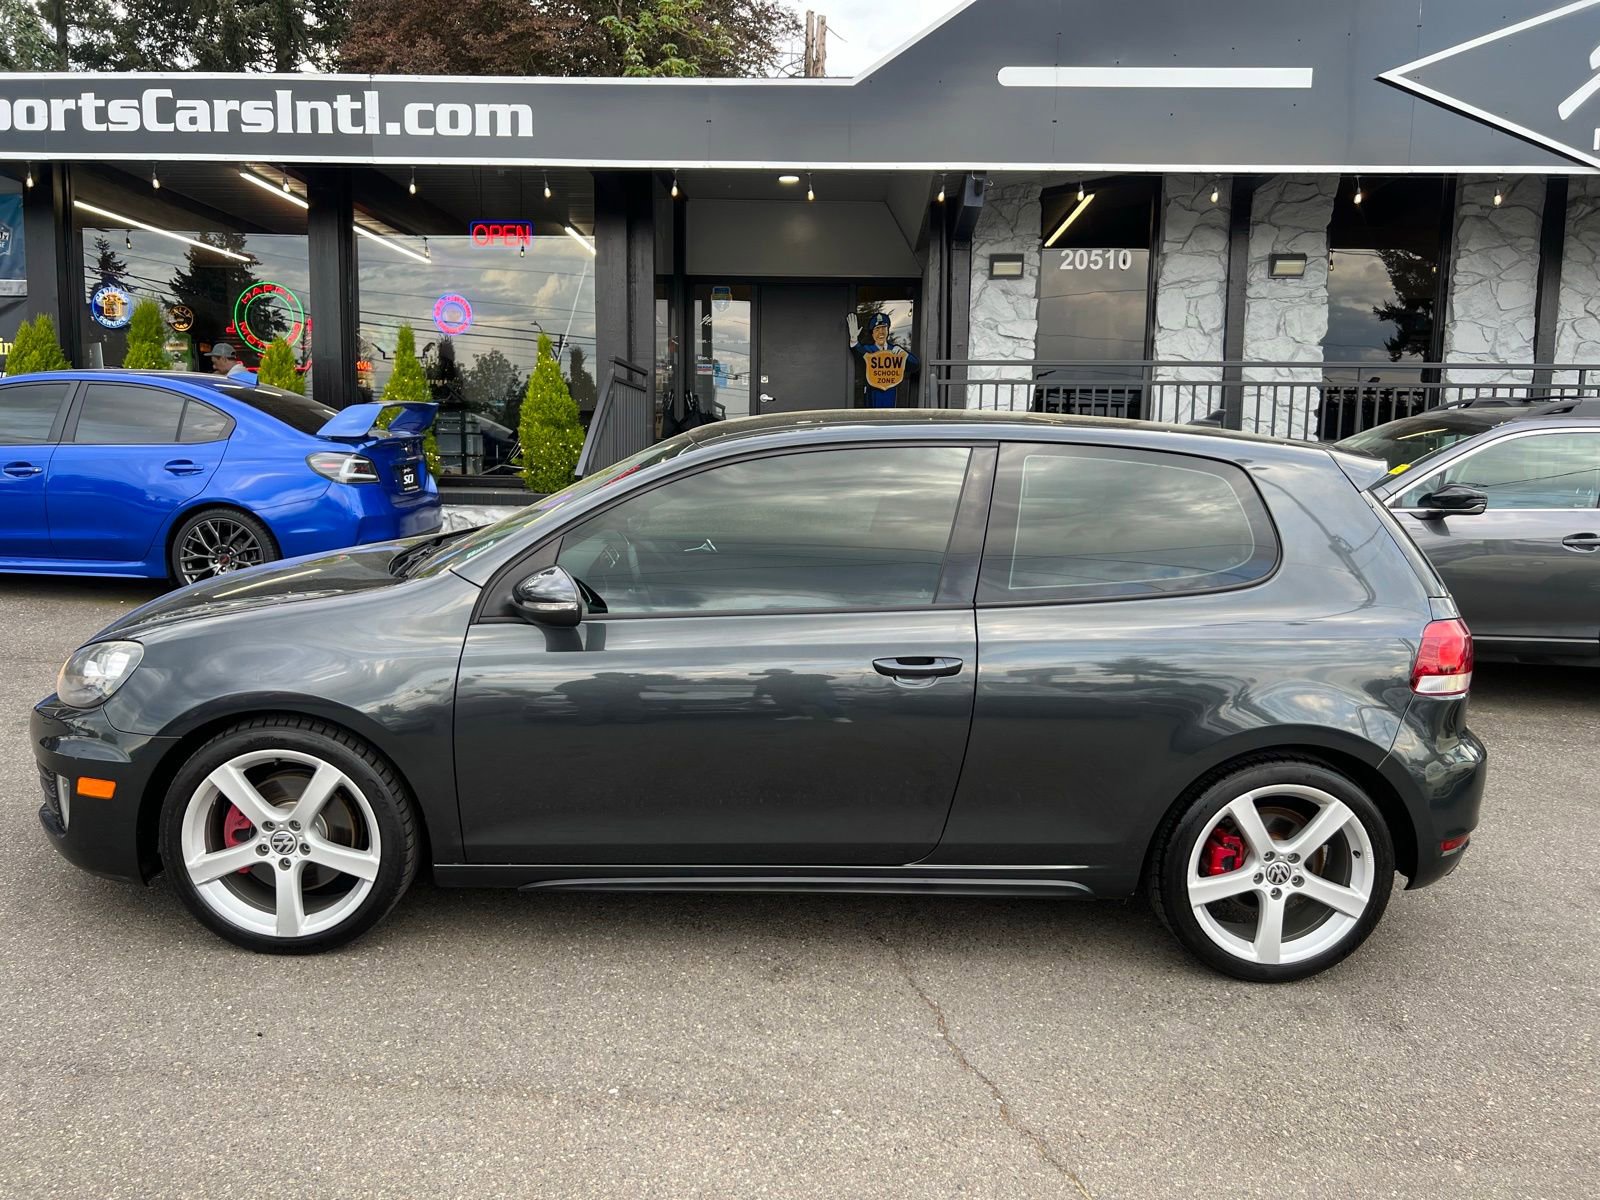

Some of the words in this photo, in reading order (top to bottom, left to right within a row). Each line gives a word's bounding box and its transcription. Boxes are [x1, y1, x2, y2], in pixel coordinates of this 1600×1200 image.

[472, 224, 530, 247] OPEN
[1060, 249, 1132, 270] 20510
[99, 315, 128, 327] SERVICE
[871, 357, 903, 369] SLOW
